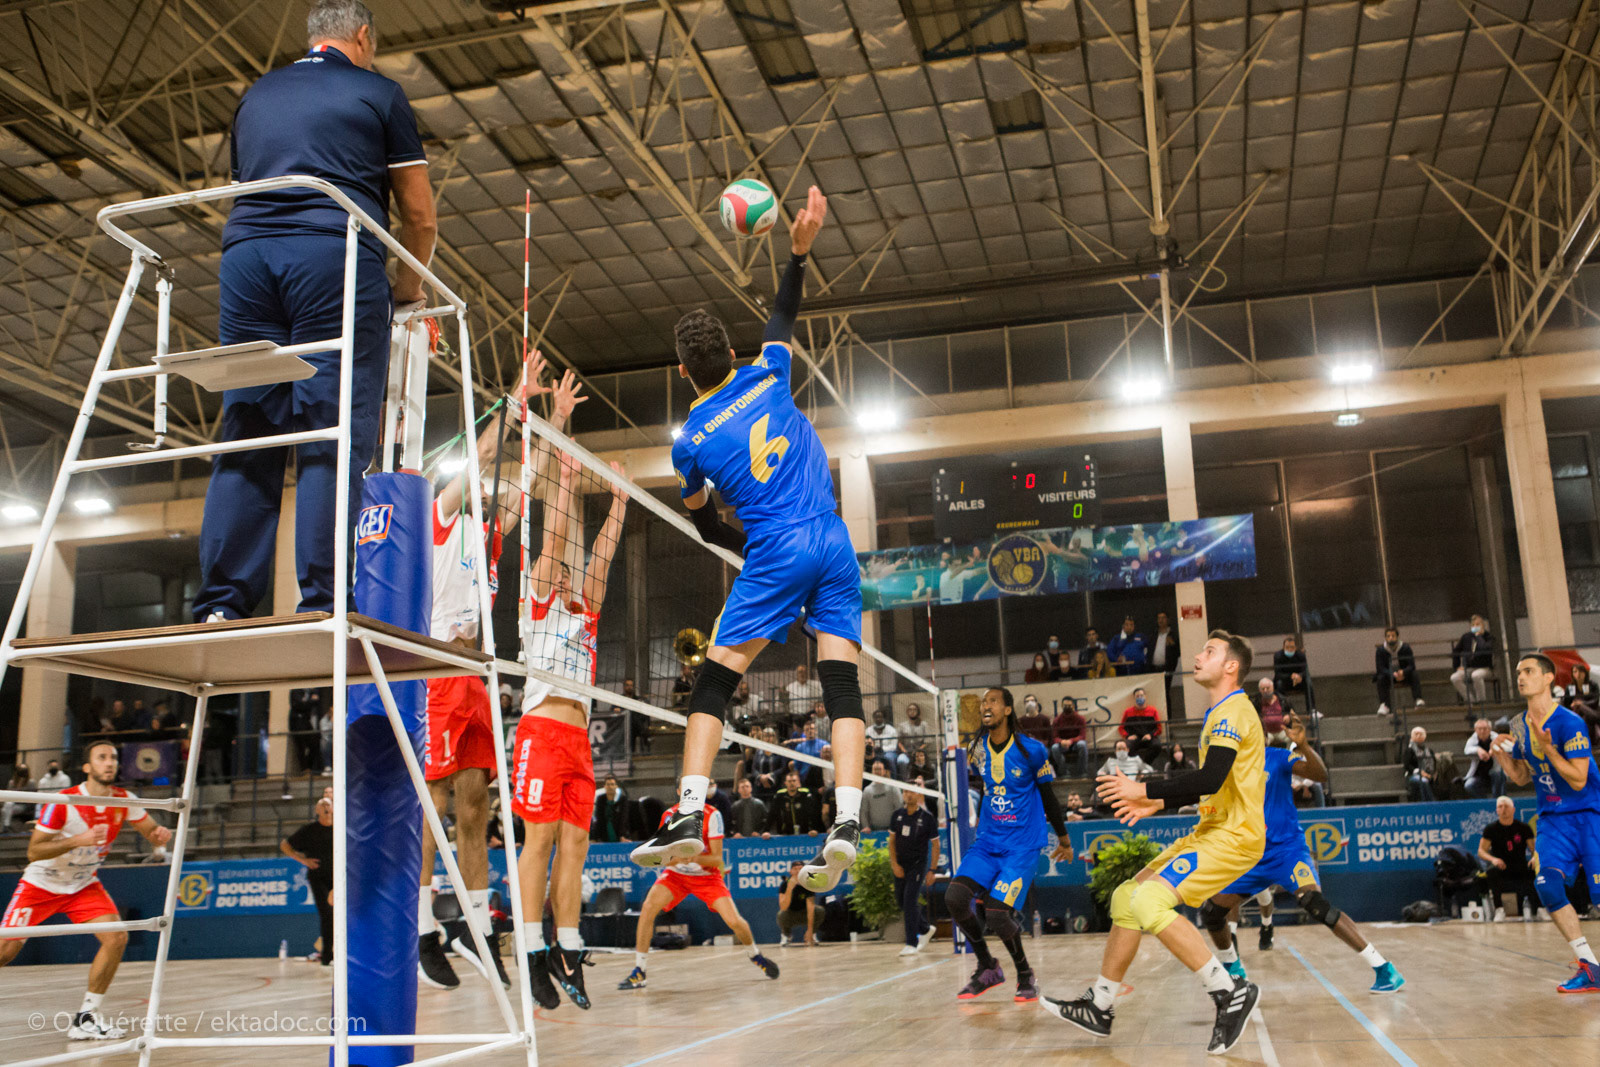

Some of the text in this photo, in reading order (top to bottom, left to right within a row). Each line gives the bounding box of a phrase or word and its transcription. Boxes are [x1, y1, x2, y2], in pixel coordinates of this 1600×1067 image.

[691, 373, 778, 446] DI GIANTOMMASO
[749, 412, 790, 484] 6
[1025, 473, 1036, 489] 0
[1038, 489, 1096, 503] VISITEURS
[949, 499, 985, 511] ARLES
[1073, 503, 1083, 519] 0
[527, 778, 545, 805] 9
[993, 785, 1007, 796] 20
[1355, 814, 1451, 829] DÉPARTEMENT
[738, 846, 821, 858] DÉPARTEMENT
[218, 868, 288, 879] DÉPARTEMENT
[995, 880, 1009, 893] 20
